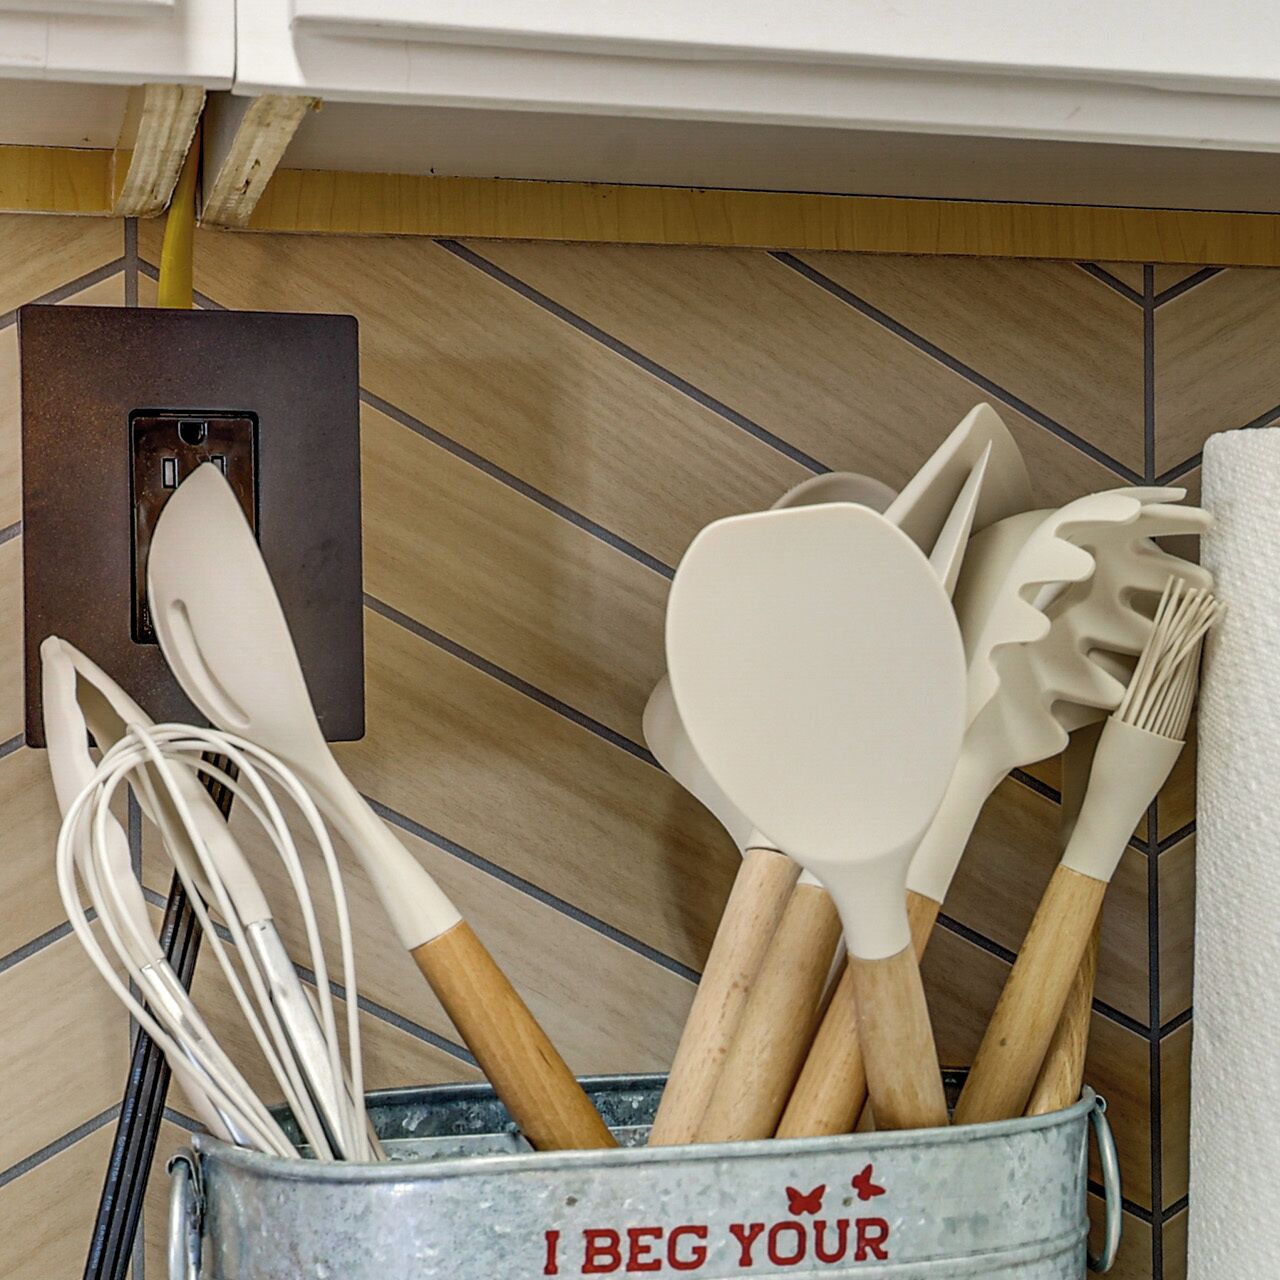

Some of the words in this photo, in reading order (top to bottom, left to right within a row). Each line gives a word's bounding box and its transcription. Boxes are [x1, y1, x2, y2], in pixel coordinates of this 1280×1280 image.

[544, 1231, 559, 1275] I
[581, 1226, 709, 1274] BEG
[729, 1218, 889, 1267] YOUR
